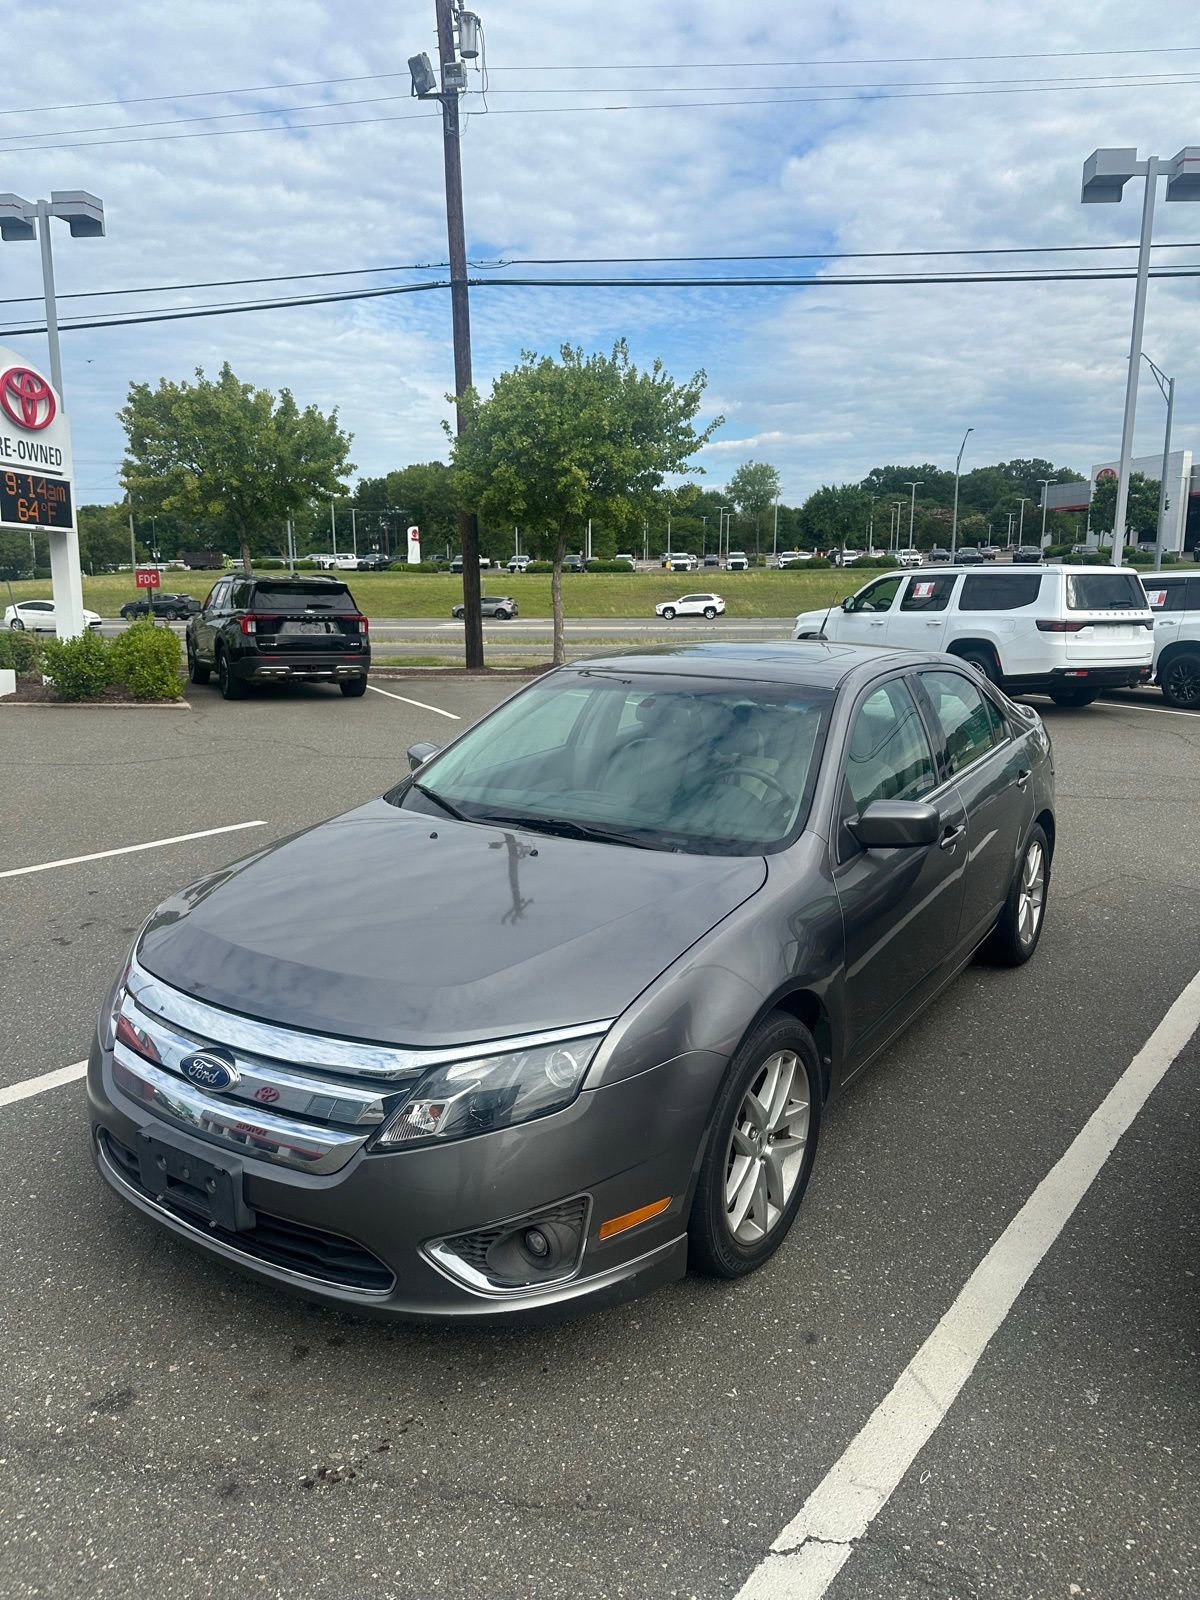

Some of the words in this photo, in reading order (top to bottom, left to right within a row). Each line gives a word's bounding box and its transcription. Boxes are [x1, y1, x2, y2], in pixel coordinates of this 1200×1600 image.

[5, 472, 66, 502] 9:14am
[138, 574, 157, 584] FDC
[188, 1058, 218, 1083] Ford
